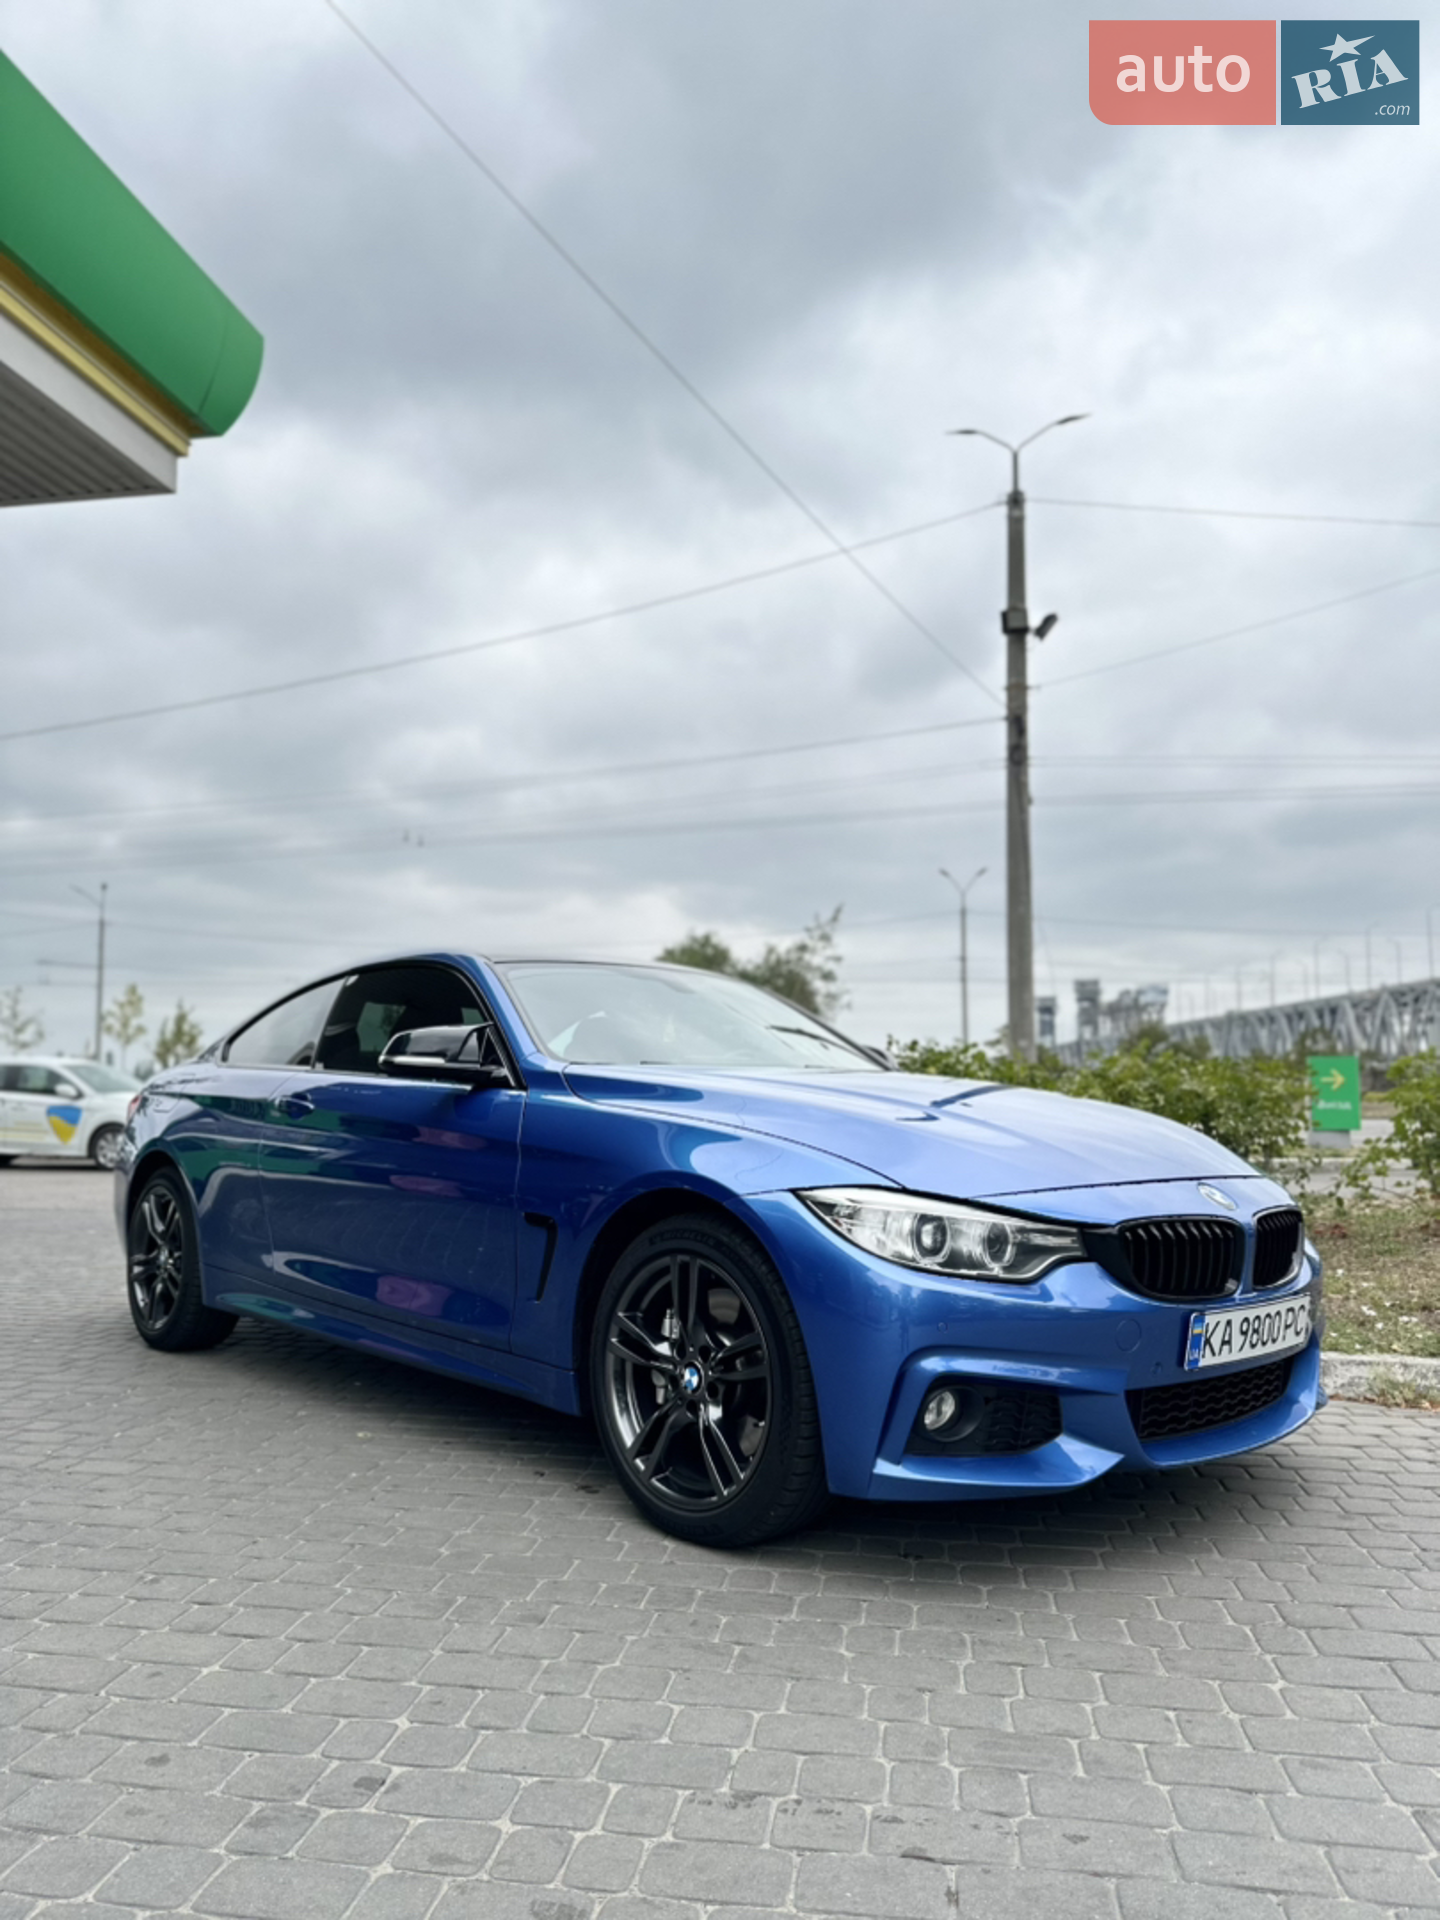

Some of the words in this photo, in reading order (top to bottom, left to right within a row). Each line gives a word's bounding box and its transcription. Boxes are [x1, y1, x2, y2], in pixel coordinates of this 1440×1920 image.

[662, 1230, 715, 1245] MICHELIN
[1202, 1319, 1233, 1359] KA
[1239, 1309, 1282, 1353] 9800
[1283, 1304, 1306, 1342] PC
